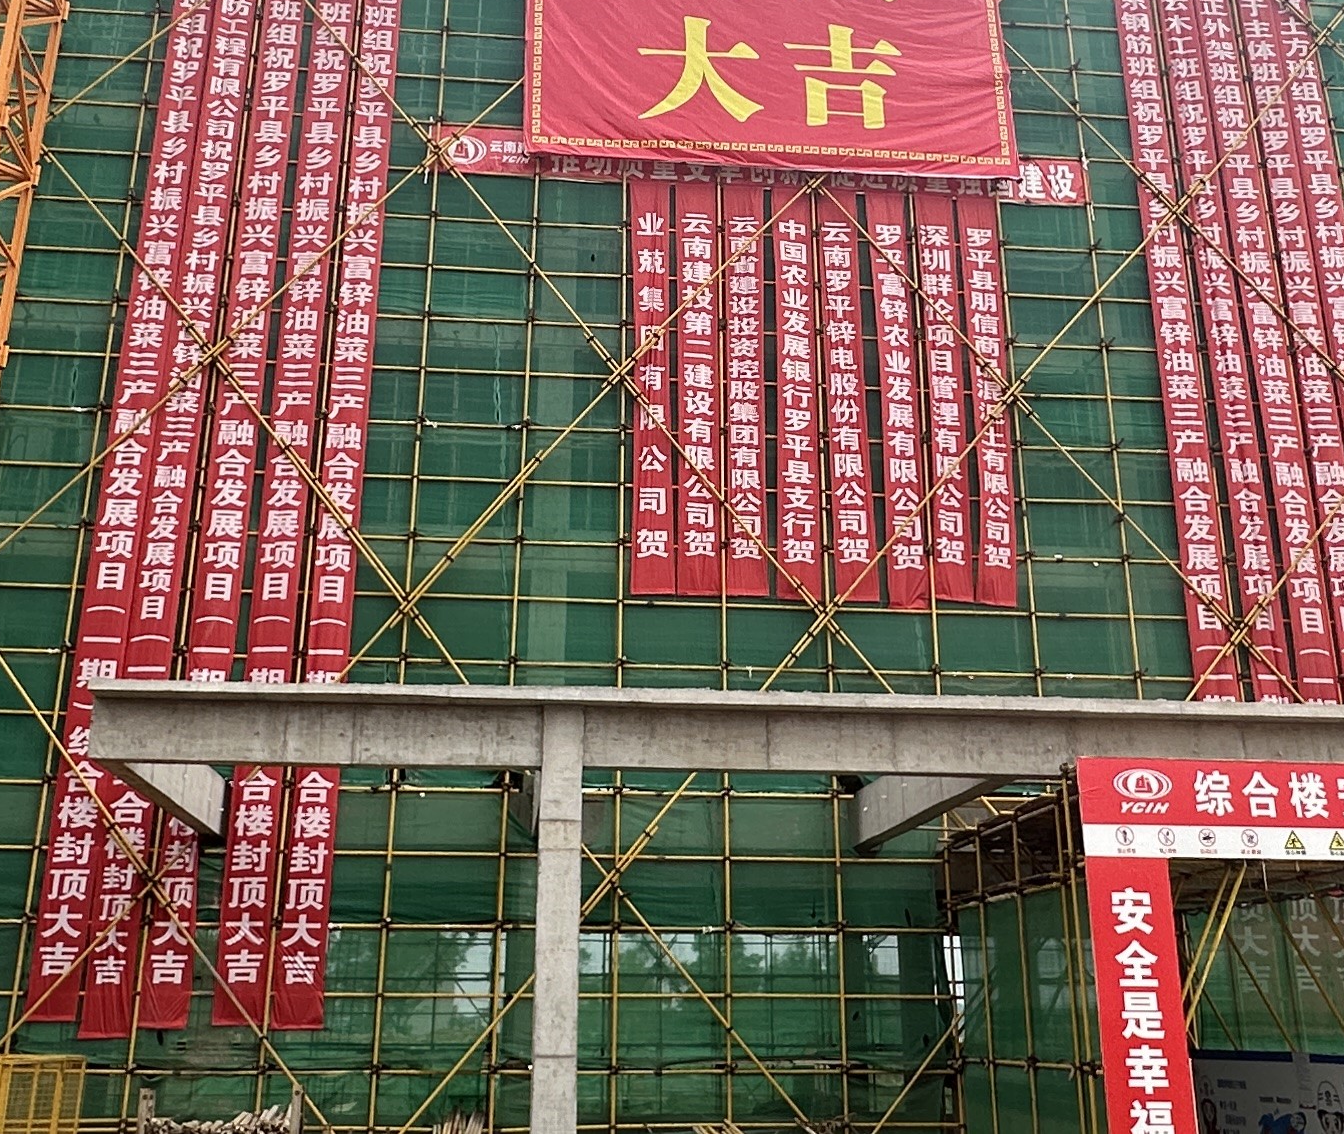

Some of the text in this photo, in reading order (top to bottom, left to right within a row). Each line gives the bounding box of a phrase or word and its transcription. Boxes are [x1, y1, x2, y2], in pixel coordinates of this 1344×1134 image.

[637, 15, 903, 130] 大吉
[681, 213, 716, 557] 云南建投第二建设有限公司贺
[728, 215, 763, 560] 云南省建设投资控股集团有限公司贺
[777, 220, 816, 564] 中国农业发展银行罗平县支行贺
[821, 220, 870, 564] 云南罗平锌电股份有限公司贺
[875, 224, 925, 571] 罗平富锌农业发展有限公司贺
[1119, 800, 1170, 815] YCIH
[1110, 888, 1175, 1134] 安全是幸福
